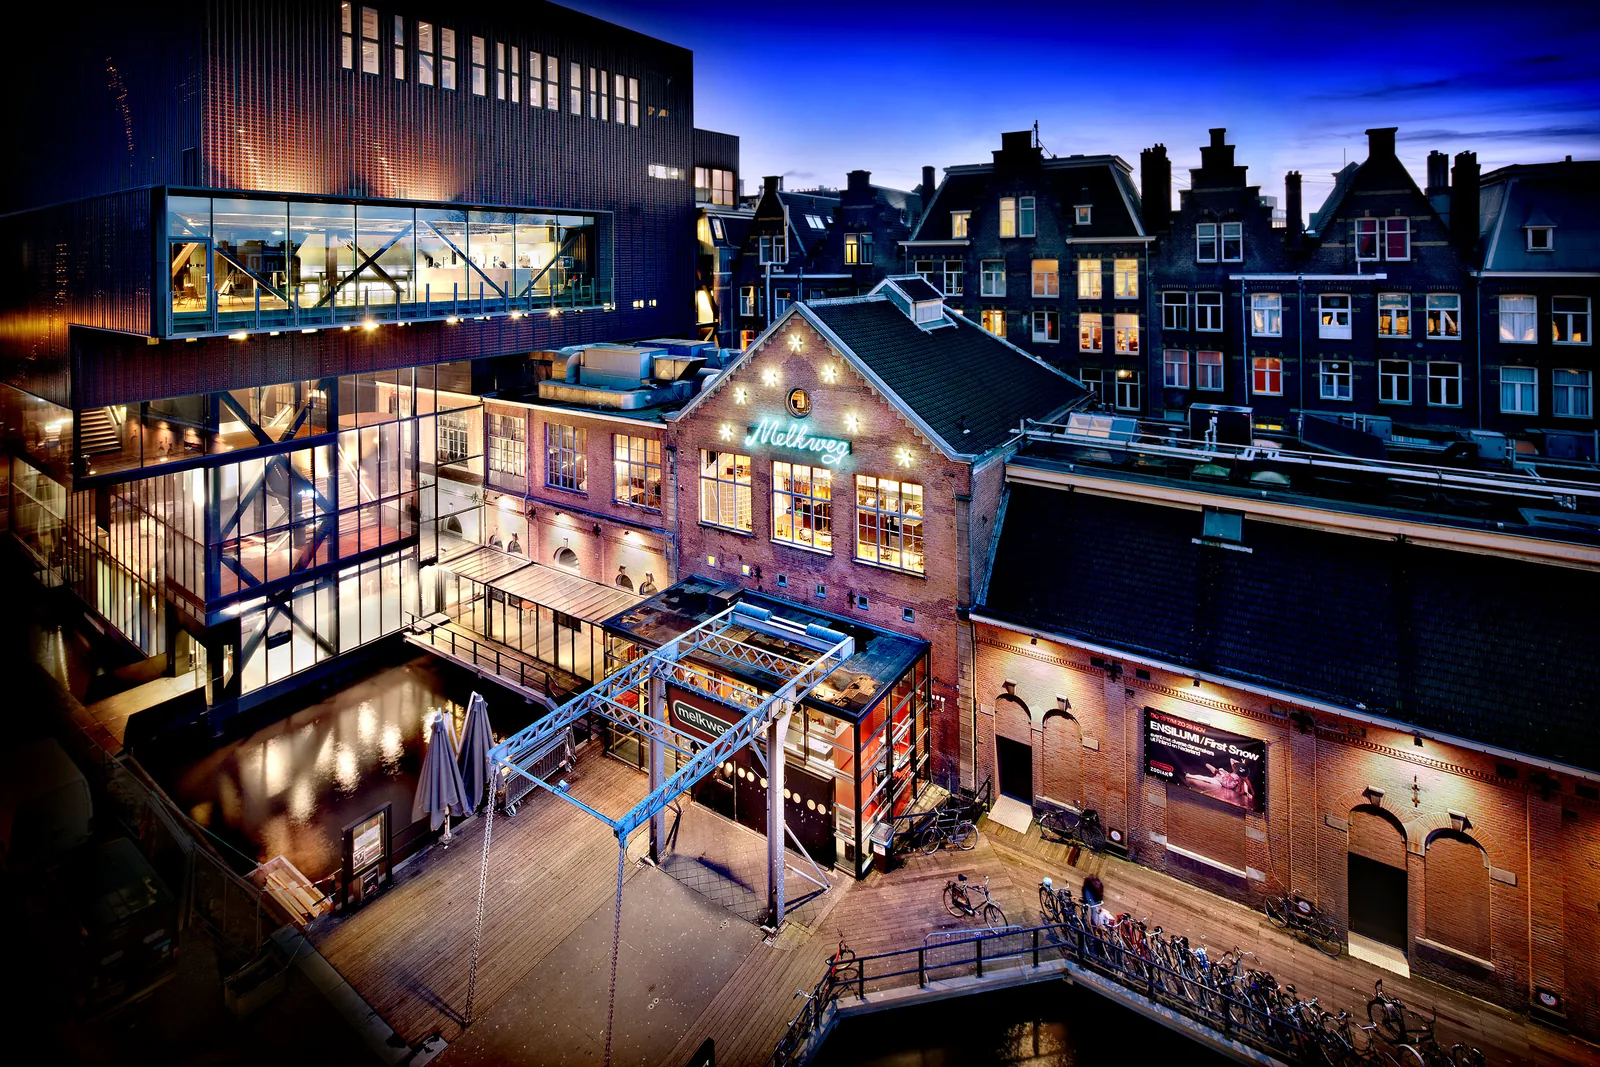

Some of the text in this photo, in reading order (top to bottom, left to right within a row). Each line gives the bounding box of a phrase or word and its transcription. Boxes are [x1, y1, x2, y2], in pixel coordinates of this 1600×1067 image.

[744, 419, 849, 465] Melkweg
[678, 706, 730, 734] melkwe
[1150, 720, 1200, 743] ENSILUMI
[1204, 737, 1228, 752] First
[1228, 744, 1260, 761] Snow
